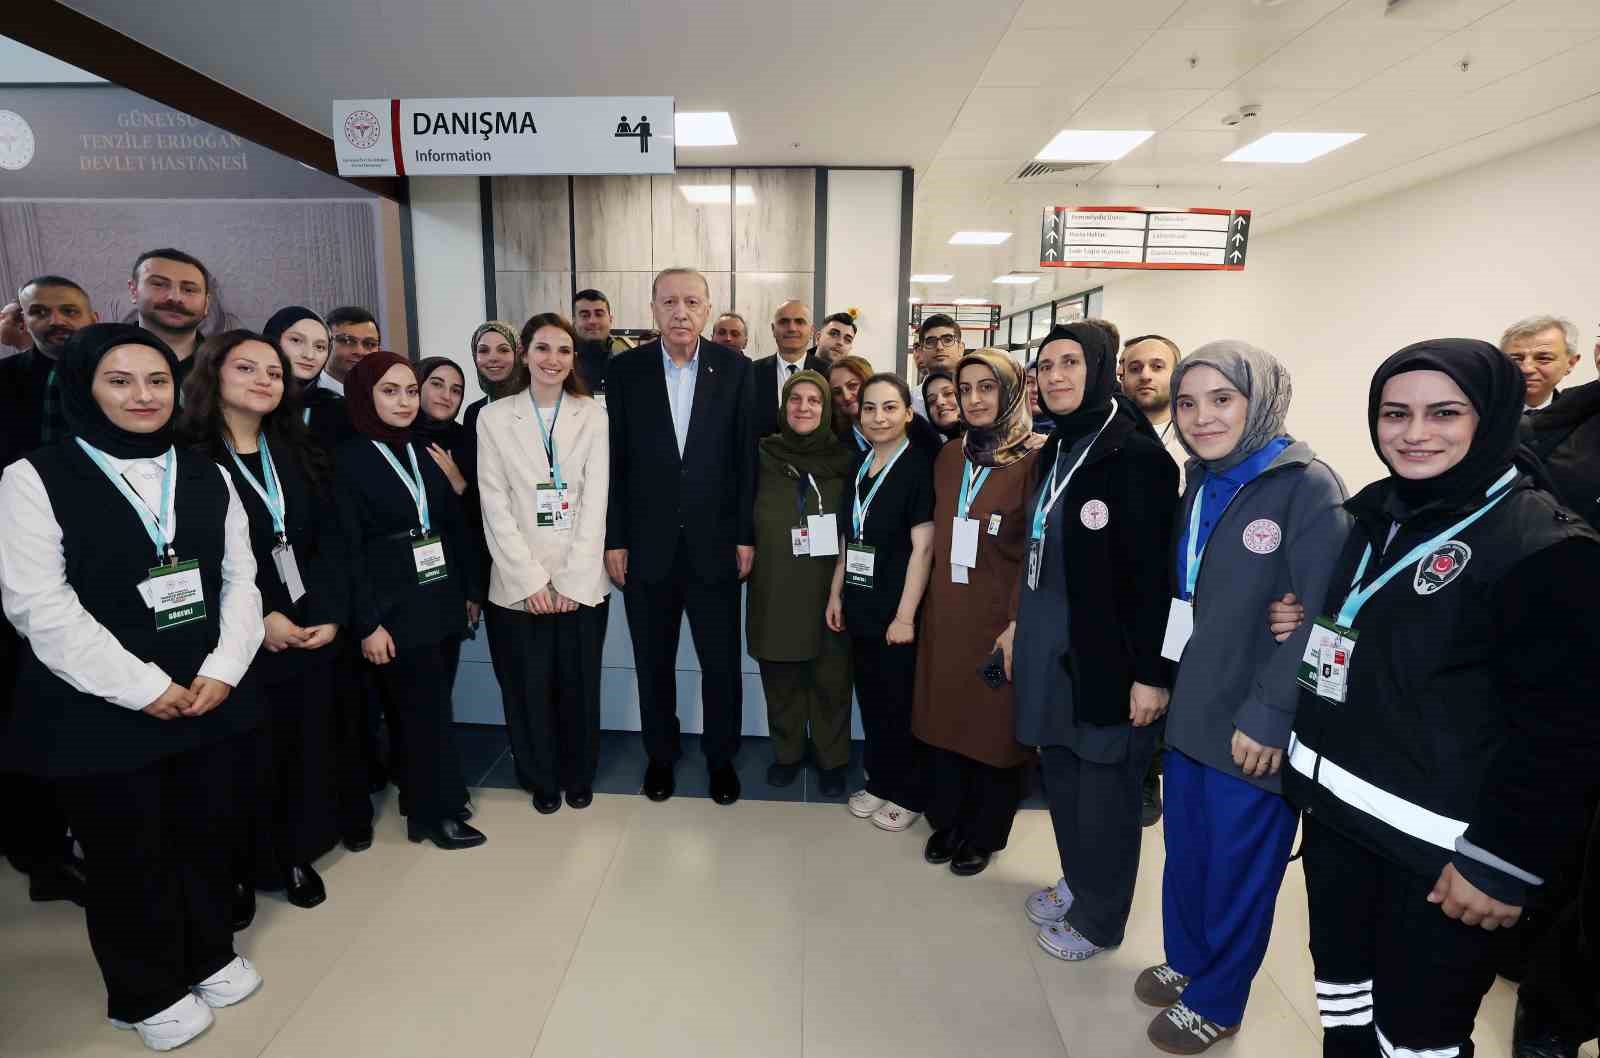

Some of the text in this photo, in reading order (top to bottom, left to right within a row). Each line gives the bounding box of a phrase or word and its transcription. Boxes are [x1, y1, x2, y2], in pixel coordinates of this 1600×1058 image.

[412, 112, 538, 141] DANIŞMA
[80, 131, 242, 149] TENZİLE ERDOĞAN
[80, 152, 248, 172] DEVLET HASTANESİ
[415, 149, 492, 163] Information
